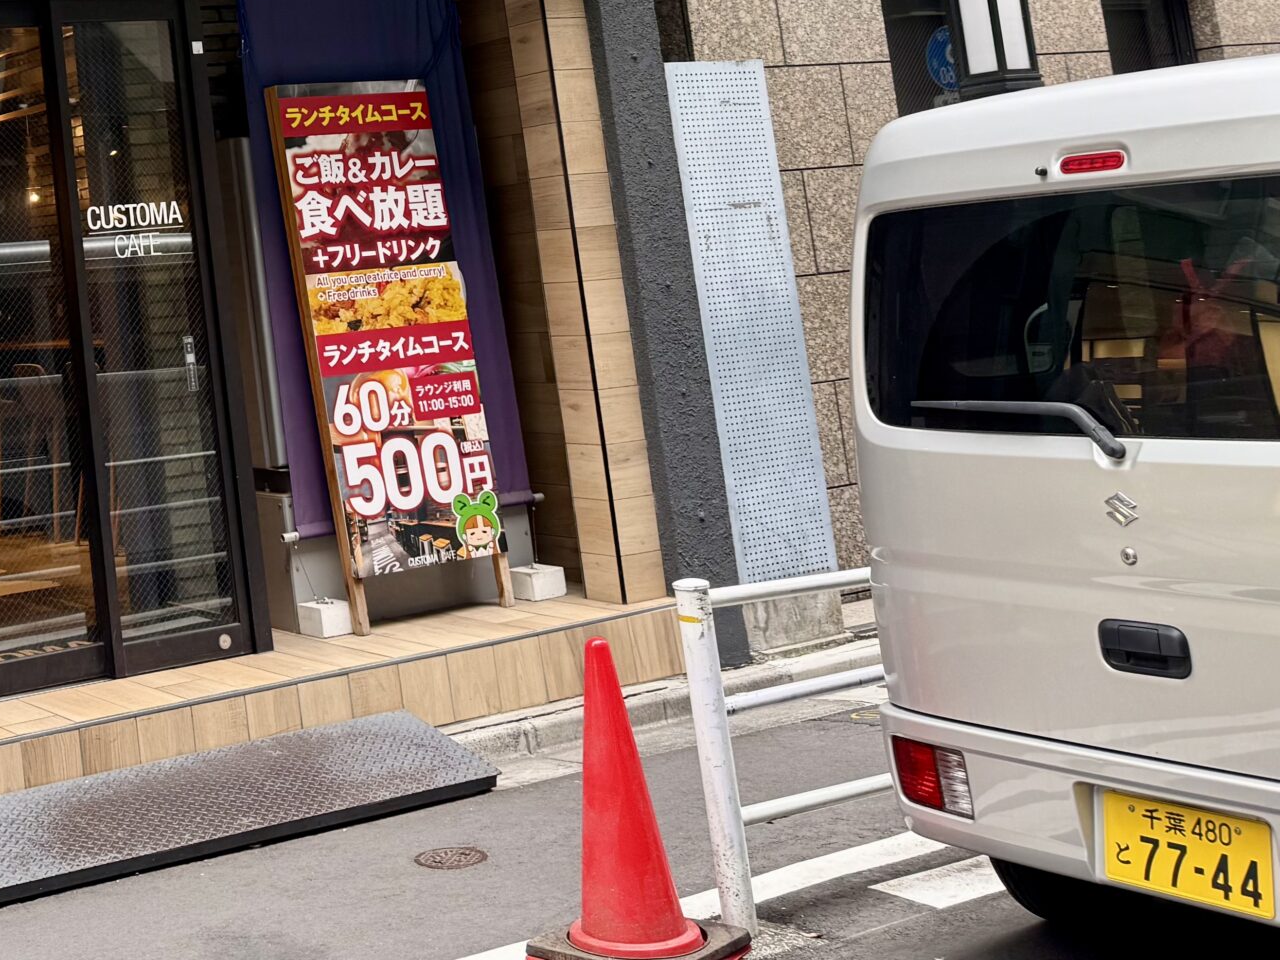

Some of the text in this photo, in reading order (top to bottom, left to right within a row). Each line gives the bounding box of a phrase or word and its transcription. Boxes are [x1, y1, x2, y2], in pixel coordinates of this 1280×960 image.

[285, 102, 427, 128] ランチタイムコース
[86, 200, 183, 230] CUSTOMA
[295, 183, 448, 239] 食べ放題
[114, 232, 162, 258] CAFE
[316, 266, 445, 287] All you can eat rice and curry!
[327, 290, 348, 300] Free
[349, 288, 377, 299] drinks
[323, 331, 470, 368] ランチタイムコース
[415, 379, 471, 397] ラウンジ利用
[333, 380, 412, 436] 60分
[418, 394, 475, 413] 11:00-15:00
[342, 431, 494, 516] 500円
[1115, 835, 1263, 909] と 77-44
